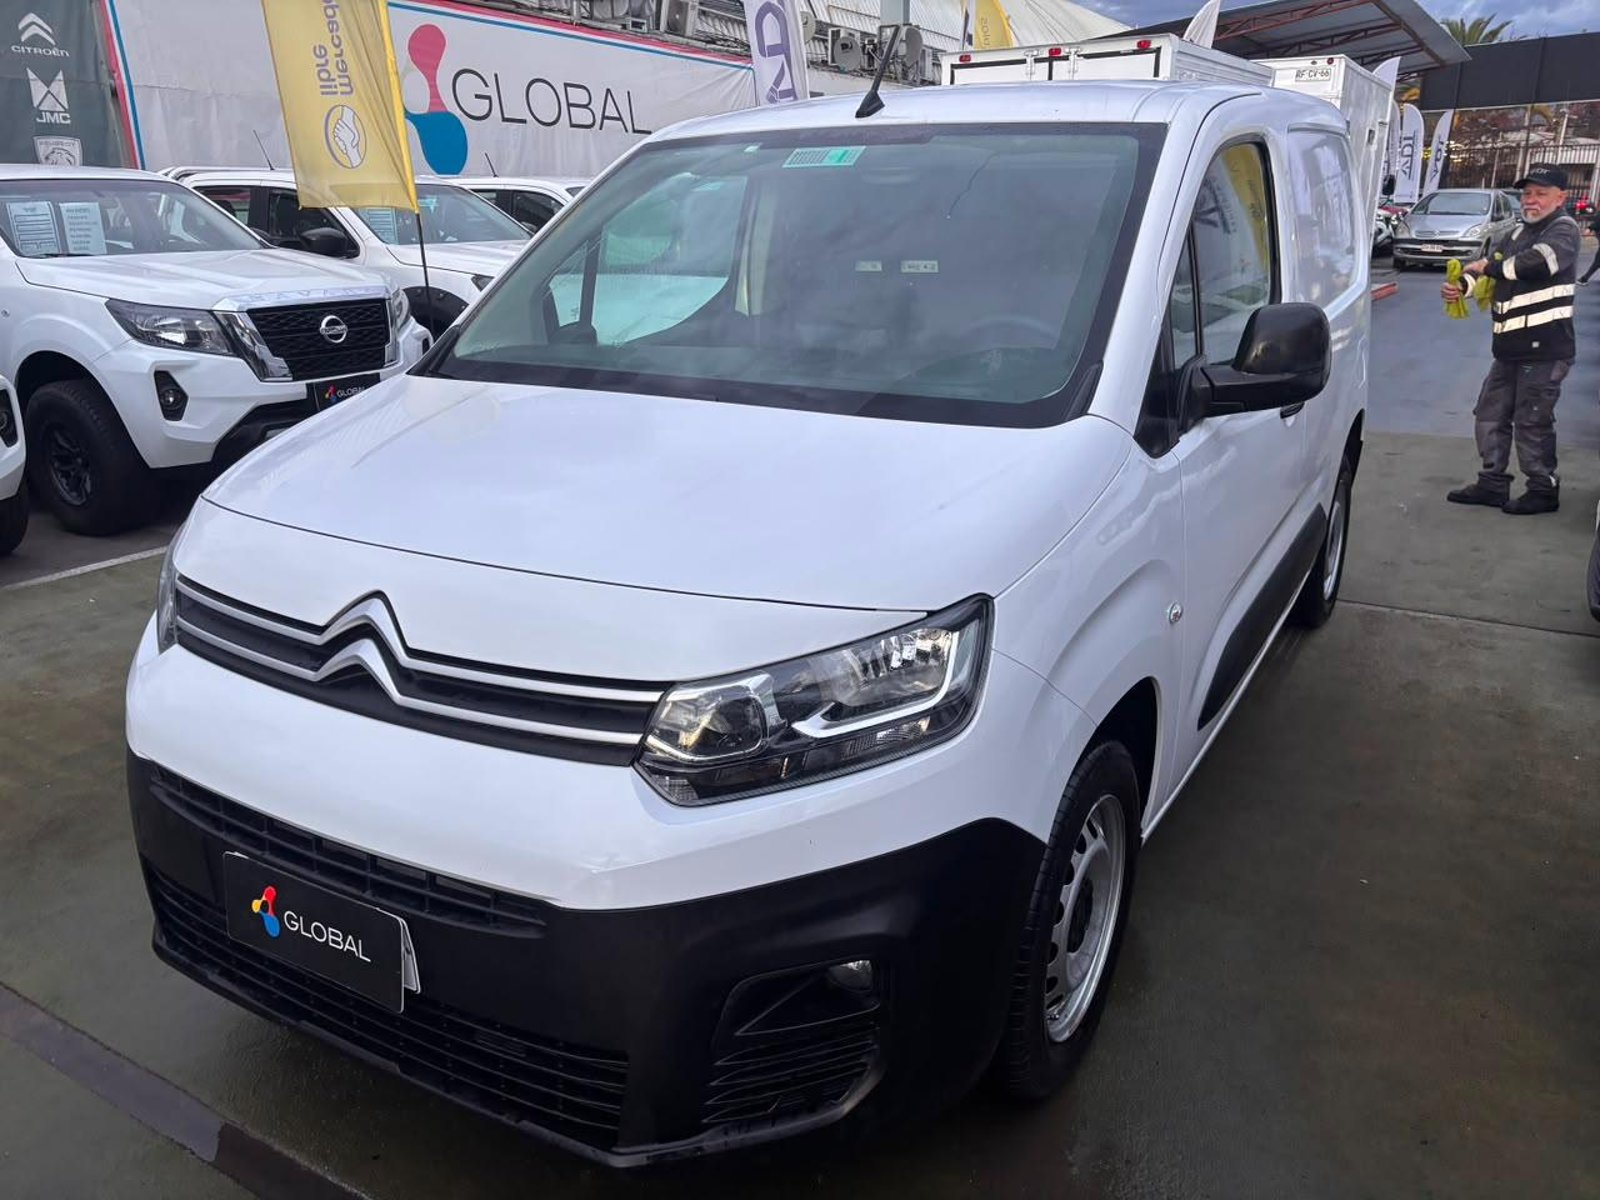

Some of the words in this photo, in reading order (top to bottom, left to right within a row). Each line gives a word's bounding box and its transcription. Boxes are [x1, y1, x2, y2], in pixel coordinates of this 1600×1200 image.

[36, 111, 71, 124] JMC
[452, 68, 652, 135] GLOBAL
[284, 910, 371, 963] GLOBAL
